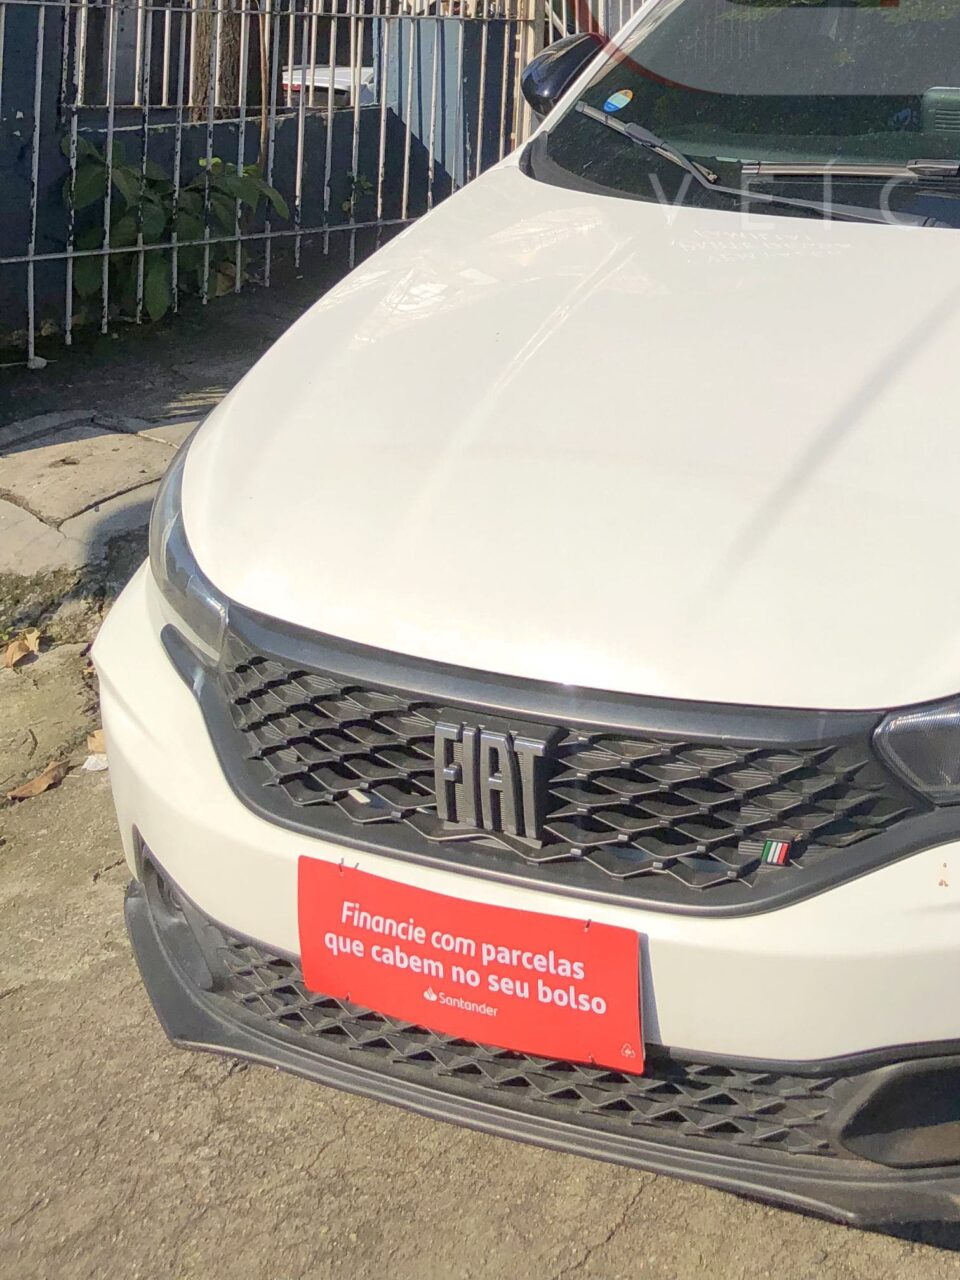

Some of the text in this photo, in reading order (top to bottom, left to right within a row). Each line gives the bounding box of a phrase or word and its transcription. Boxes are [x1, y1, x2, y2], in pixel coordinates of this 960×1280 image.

[434, 721, 546, 839] FIAT
[324, 932, 607, 1015] que cabem no seu bolso
[341, 901, 585, 980] Financie com parcelas
[438, 991, 498, 1017] Santander
